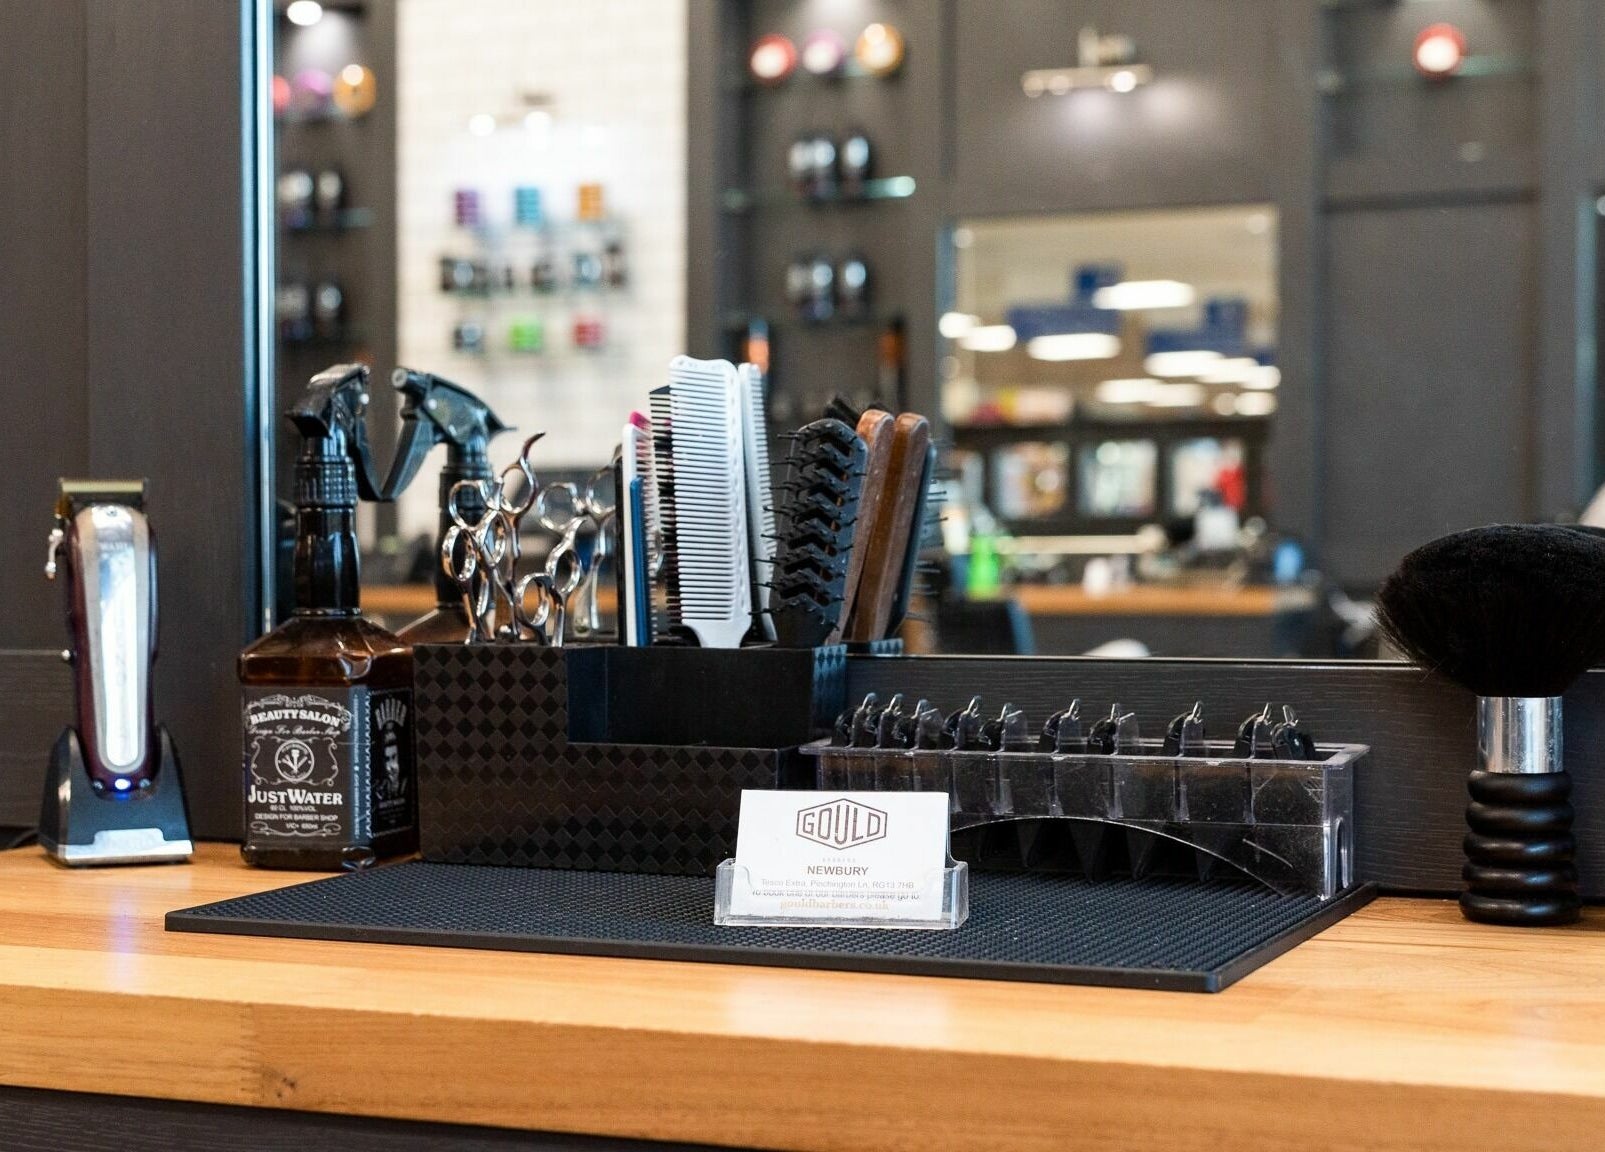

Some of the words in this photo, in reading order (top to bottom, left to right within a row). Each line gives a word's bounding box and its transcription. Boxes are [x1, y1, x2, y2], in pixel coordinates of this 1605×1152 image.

[254, 812, 279, 820] DESIGN
[294, 813, 320, 821] BARBER
[802, 804, 881, 845] GOULD
[807, 865, 869, 876] NEWBURY
